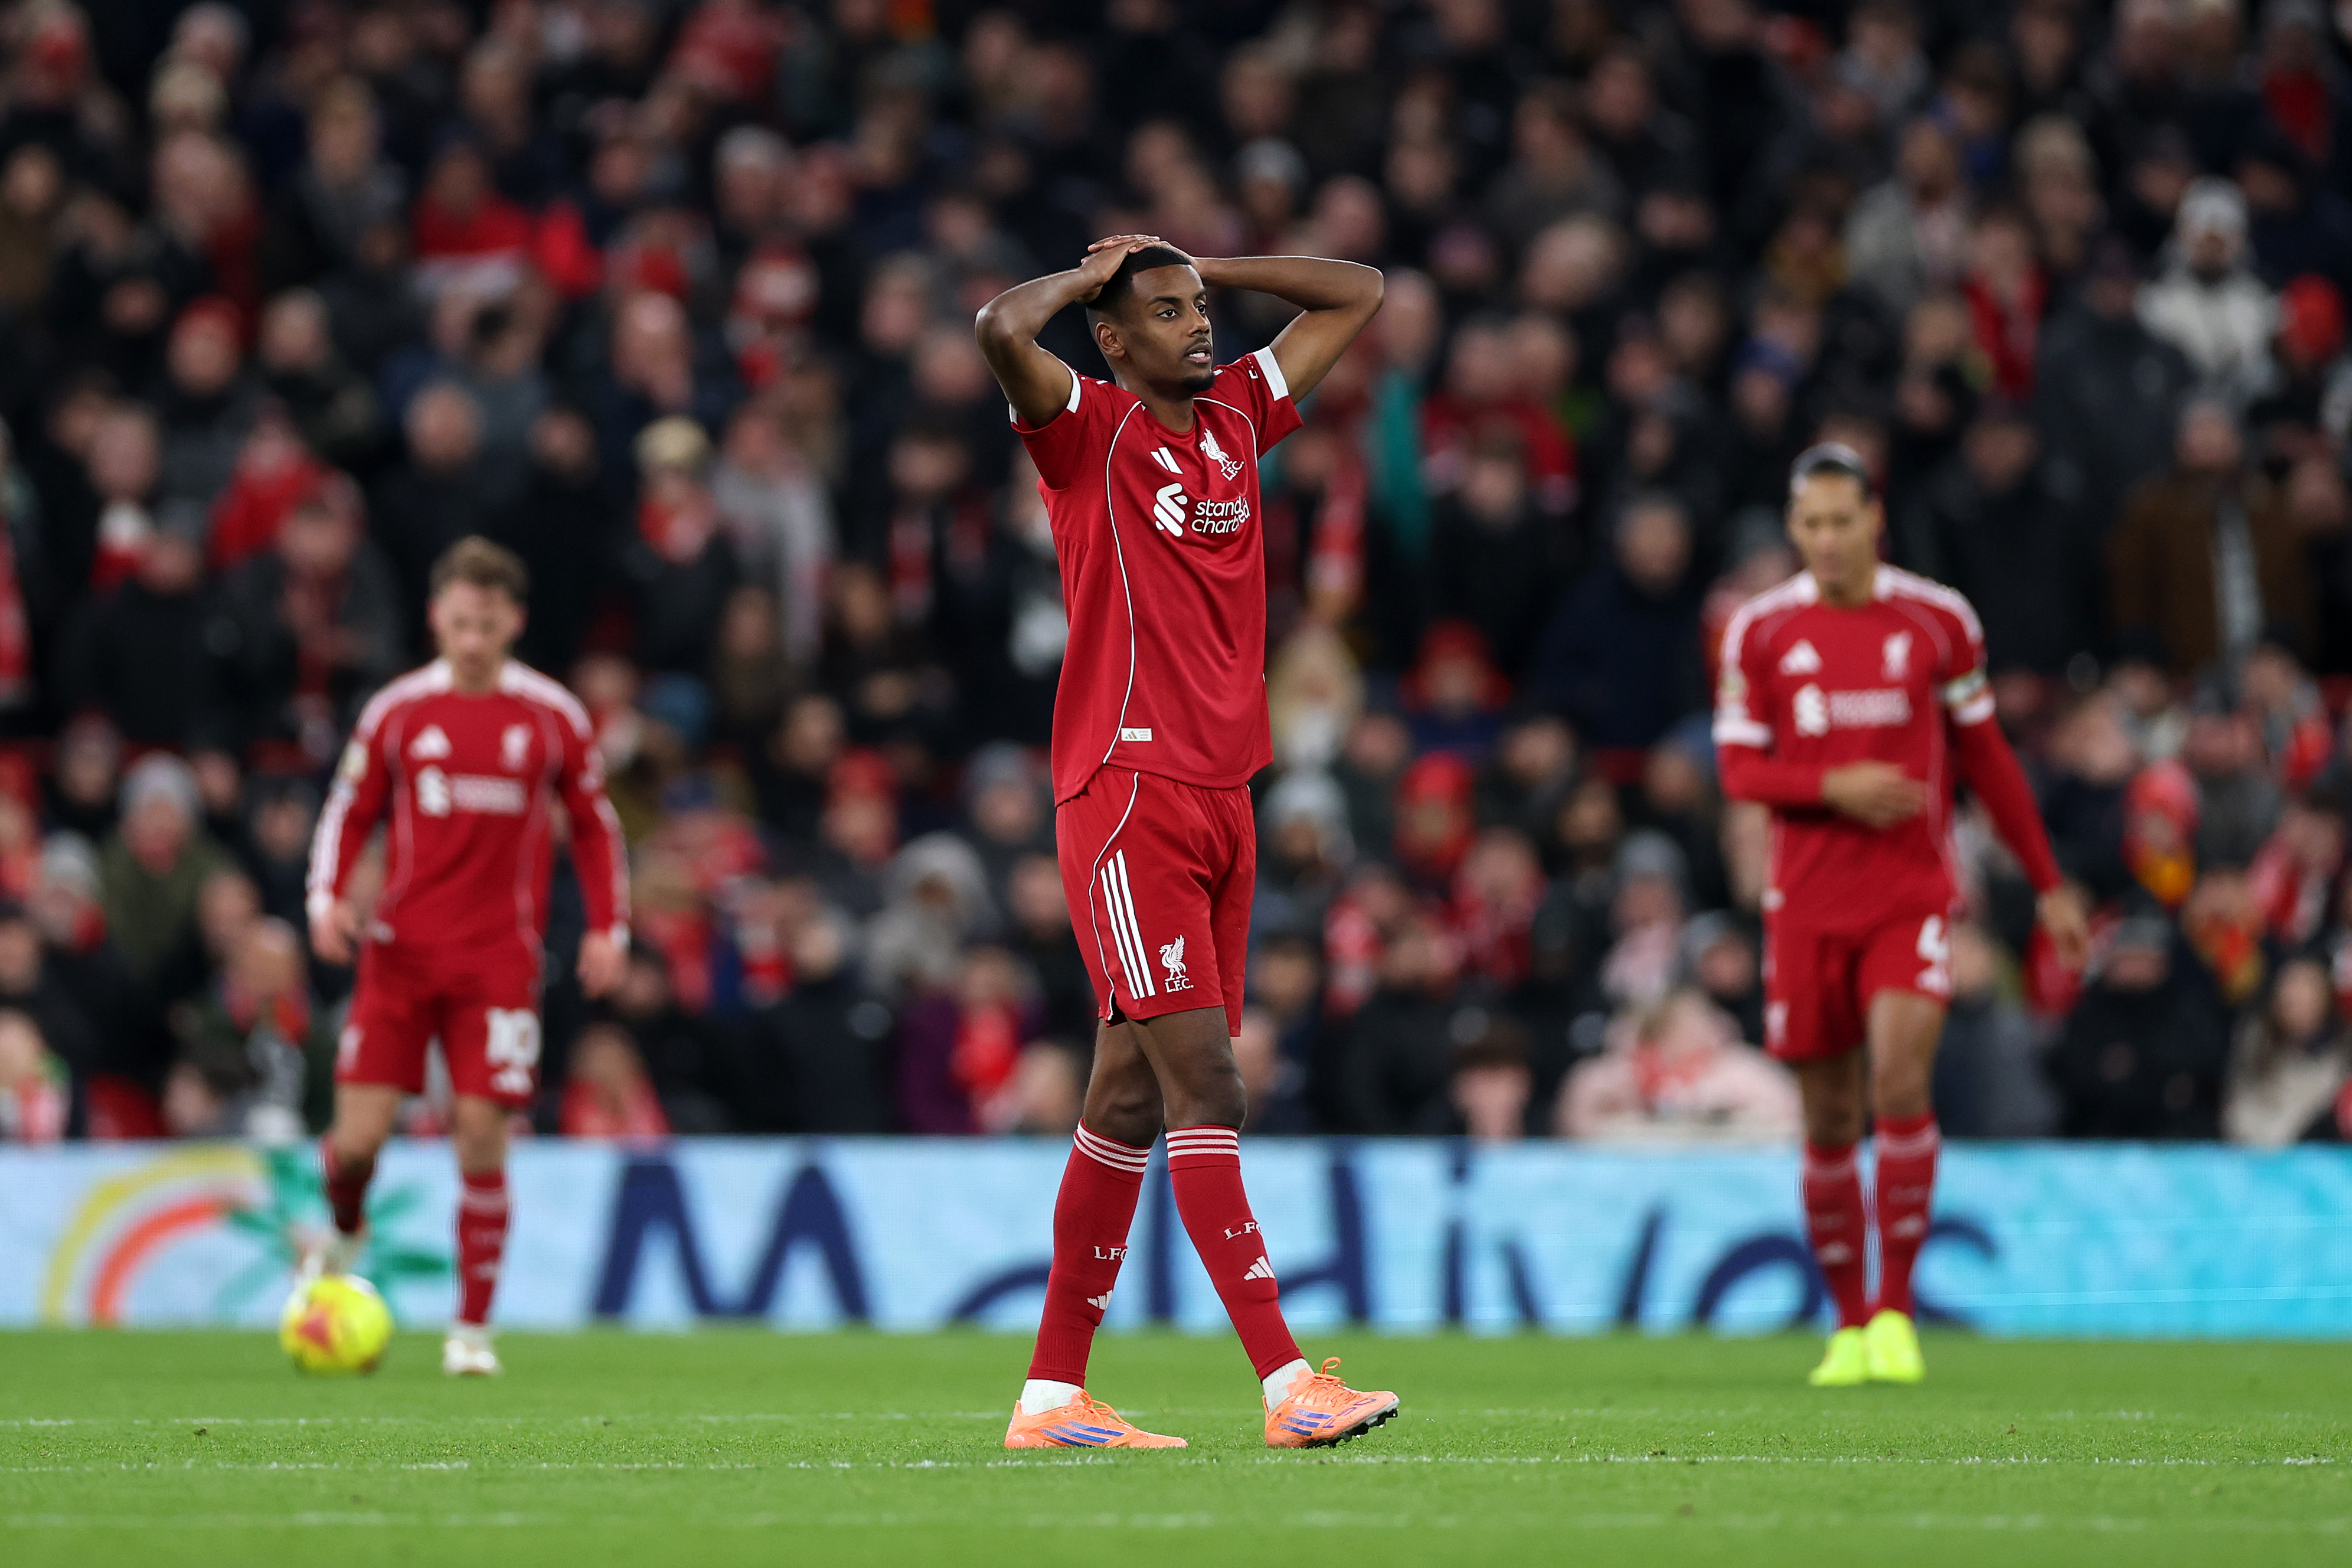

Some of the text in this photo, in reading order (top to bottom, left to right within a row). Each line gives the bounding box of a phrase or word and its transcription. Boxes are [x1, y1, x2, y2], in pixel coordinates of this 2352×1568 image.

[1195, 495, 1246, 517] stand
[1164, 978, 1194, 993] L.F.C.
[485, 1007, 544, 1069] 10
